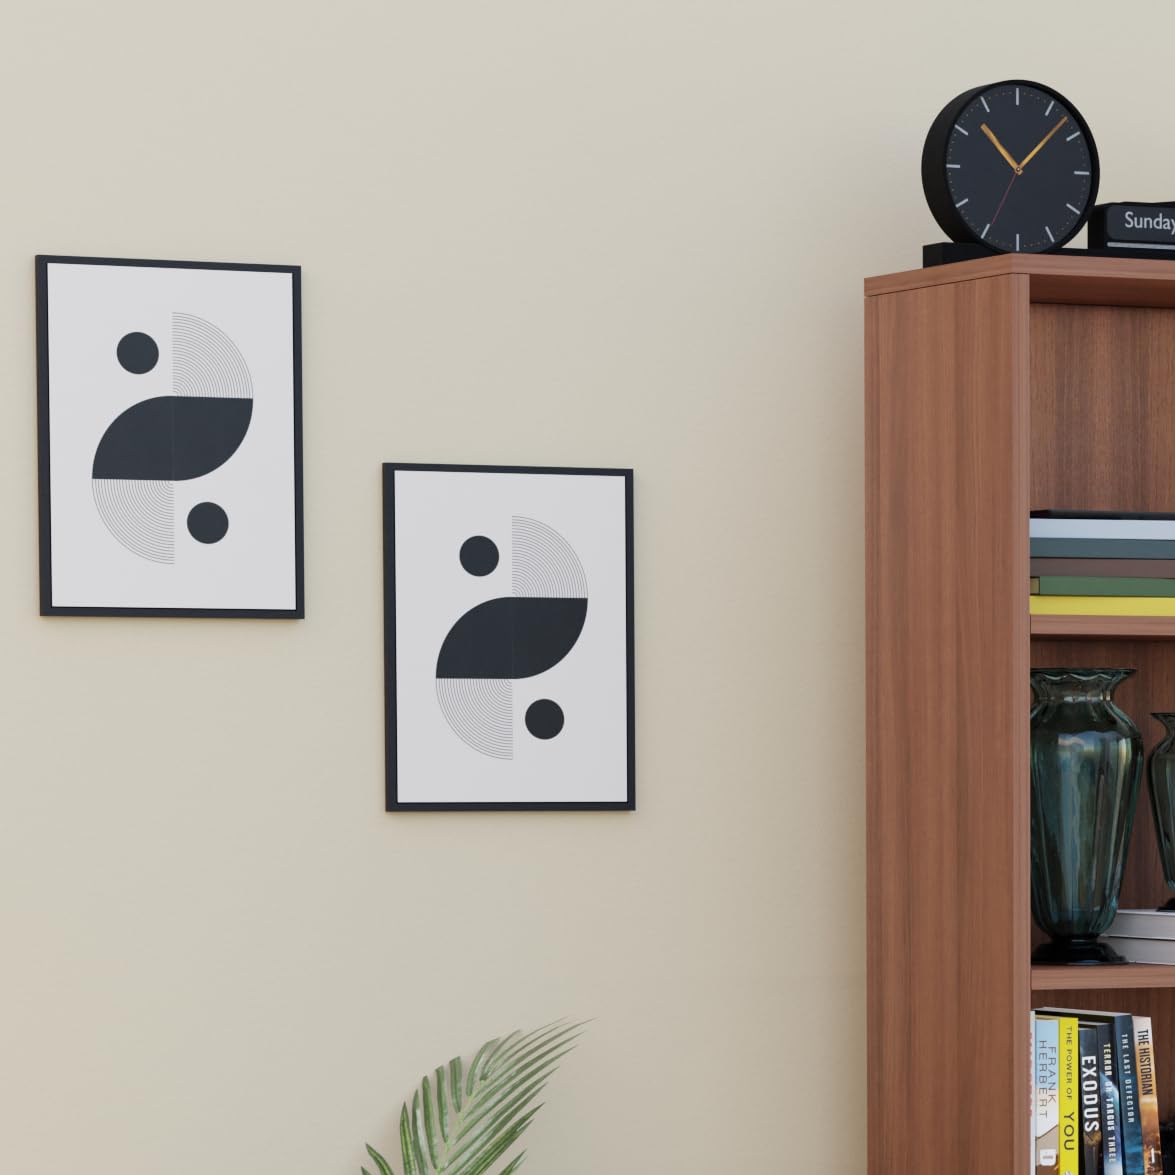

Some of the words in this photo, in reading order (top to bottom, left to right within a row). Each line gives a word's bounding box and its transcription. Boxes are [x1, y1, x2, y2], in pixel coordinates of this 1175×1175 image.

[1065, 1026, 1073, 1045] THE
[1121, 1033, 1129, 1049] THE
[1137, 1028, 1149, 1046] THE
[1047, 1046, 1056, 1103] FRANK
[1065, 1049, 1073, 1084] POWER
[1103, 1043, 1112, 1076] TERROR
[1122, 1054, 1131, 1074] LAST
[1138, 1047, 1154, 1096] HISTORIAN
[1039, 1040, 1048, 1118] HERBERT
[1066, 1087, 1073, 1100] OF
[1081, 1055, 1100, 1132] EXODUS
[1105, 1097, 1115, 1131] TARGUS
[1124, 1079, 1135, 1123] DEFECTOR
[1064, 1111, 1075, 1150] YOU
[1108, 1135, 1117, 1163] THREE
